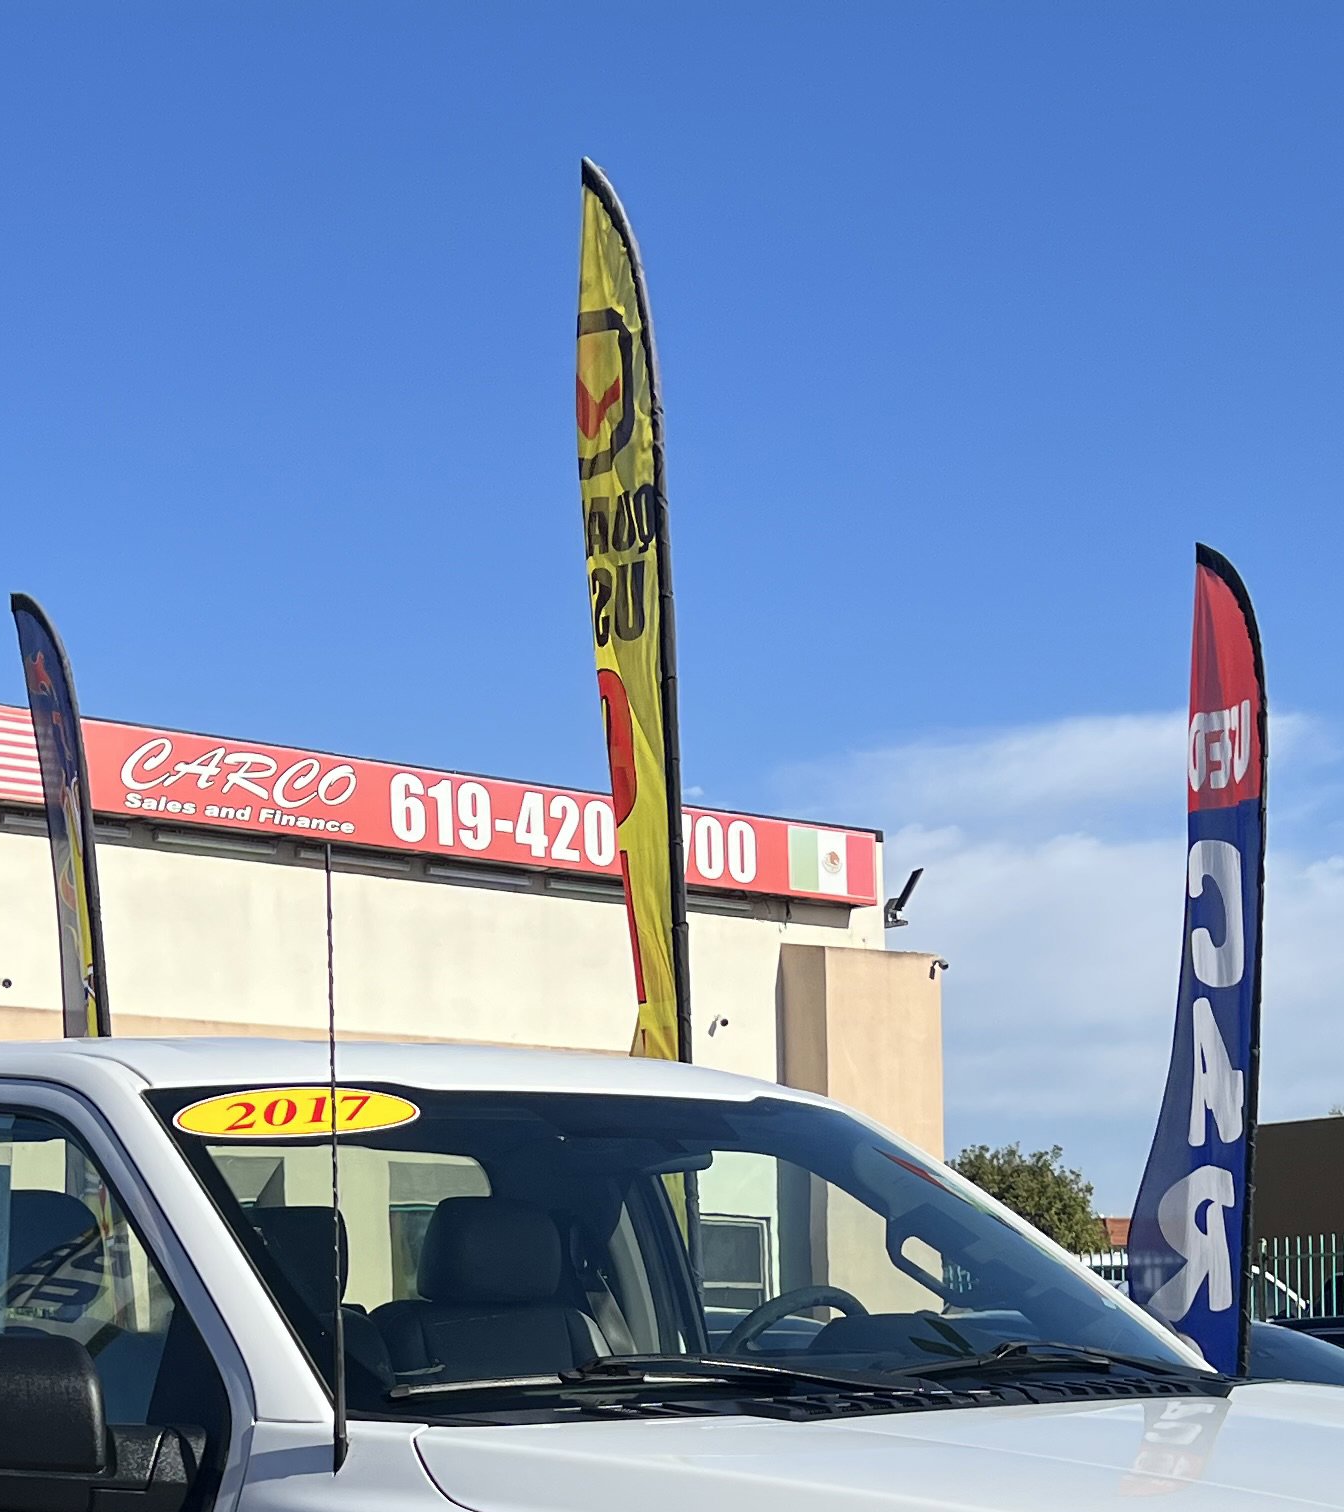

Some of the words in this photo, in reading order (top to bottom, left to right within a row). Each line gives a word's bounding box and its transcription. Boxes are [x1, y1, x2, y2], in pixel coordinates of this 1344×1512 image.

[120, 737, 357, 809] CARCO
[124, 792, 197, 815] Sales
[204, 803, 252, 822] and
[258, 807, 355, 834] Finance
[224, 1096, 371, 1131] 2017
